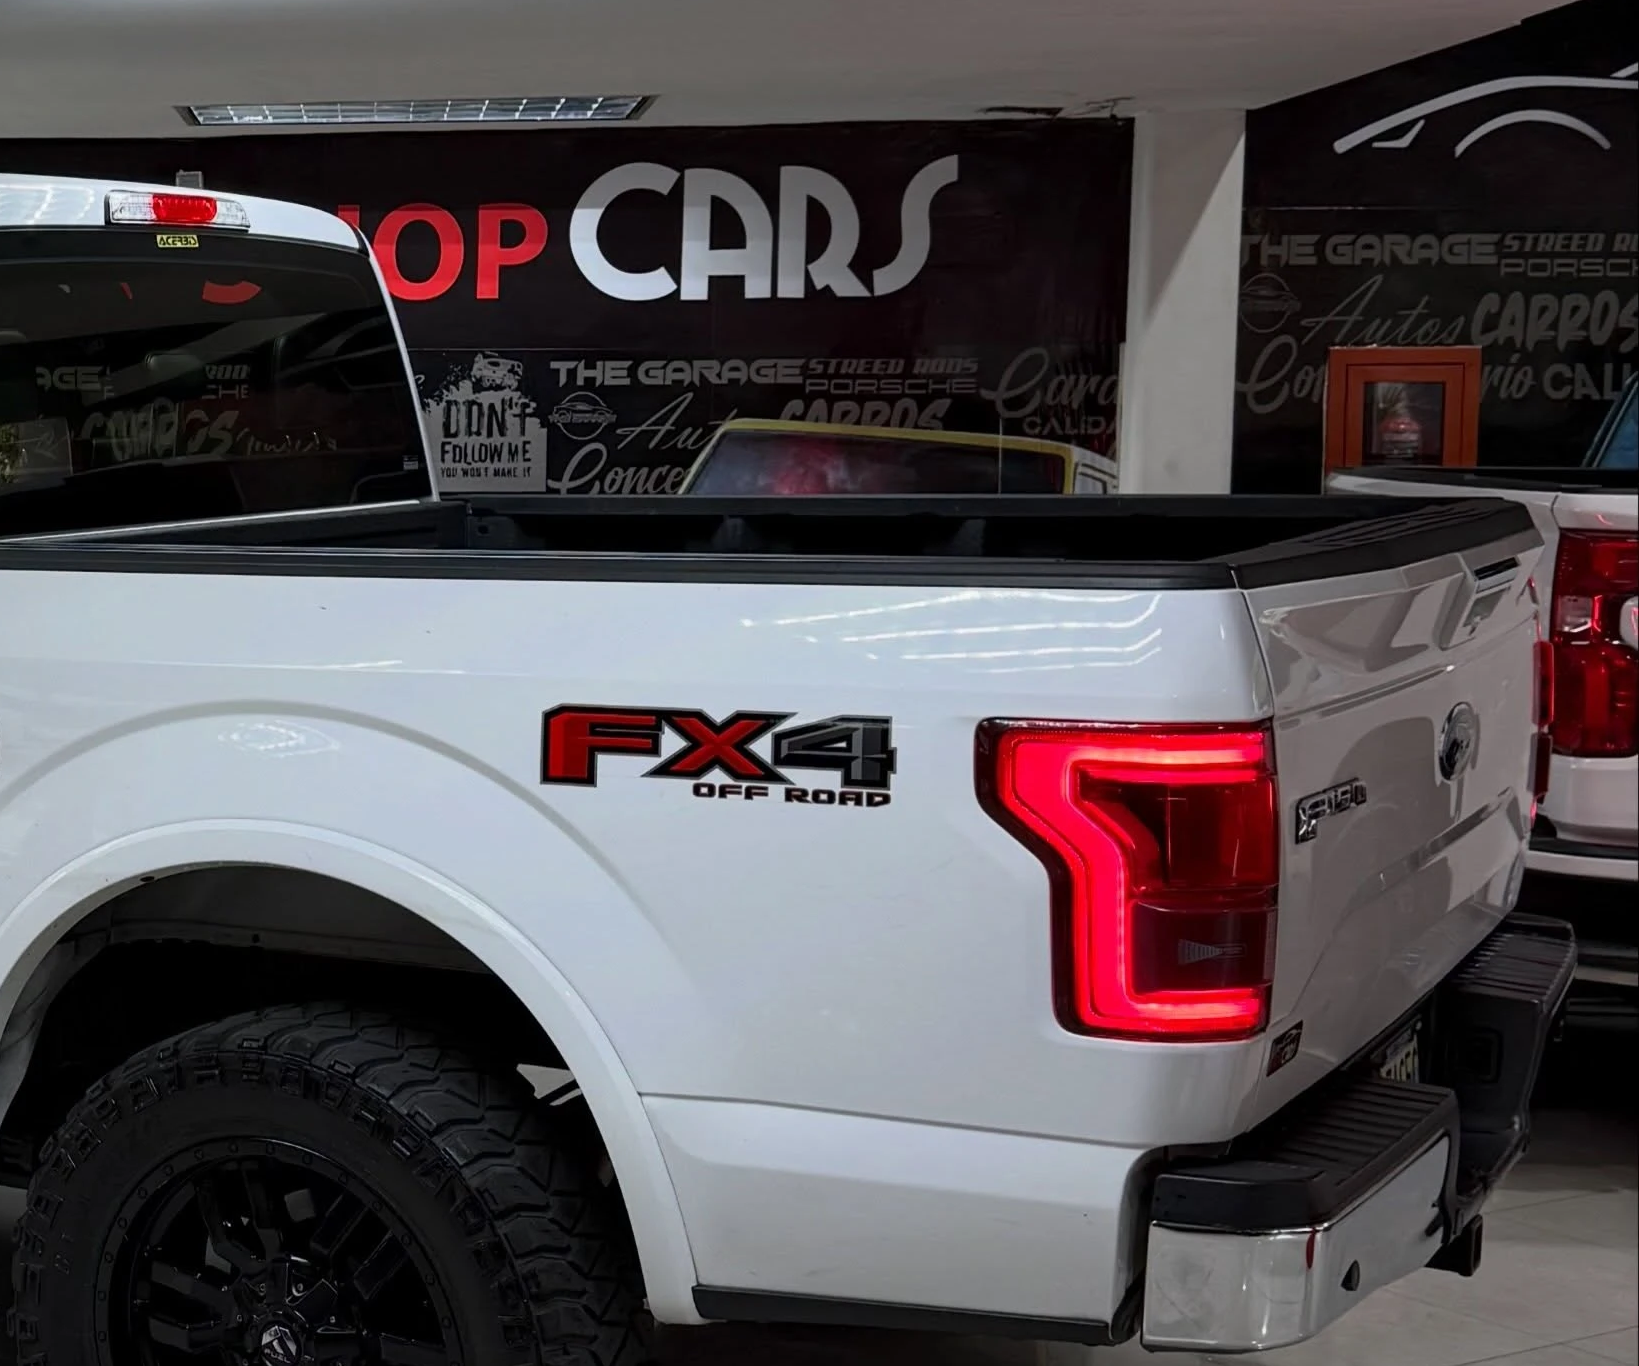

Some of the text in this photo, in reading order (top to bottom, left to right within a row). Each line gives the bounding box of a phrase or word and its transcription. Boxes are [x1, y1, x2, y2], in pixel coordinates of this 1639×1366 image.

[337, 154, 959, 301] OP CARS
[1324, 233, 1500, 268] GARAGE
[1502, 232, 1606, 252] STREED
[1302, 274, 1466, 347] Autos
[550, 359, 806, 387] THE GARAGE
[807, 358, 978, 374] STREED RODS
[805, 379, 978, 394] PORSCHE
[442, 397, 535, 439] DON'T
[440, 441, 503, 466] FOLLOW
[507, 441, 532, 464] ME
[540, 704, 897, 790] FX4
[692, 782, 892, 807] OFF ROAD
